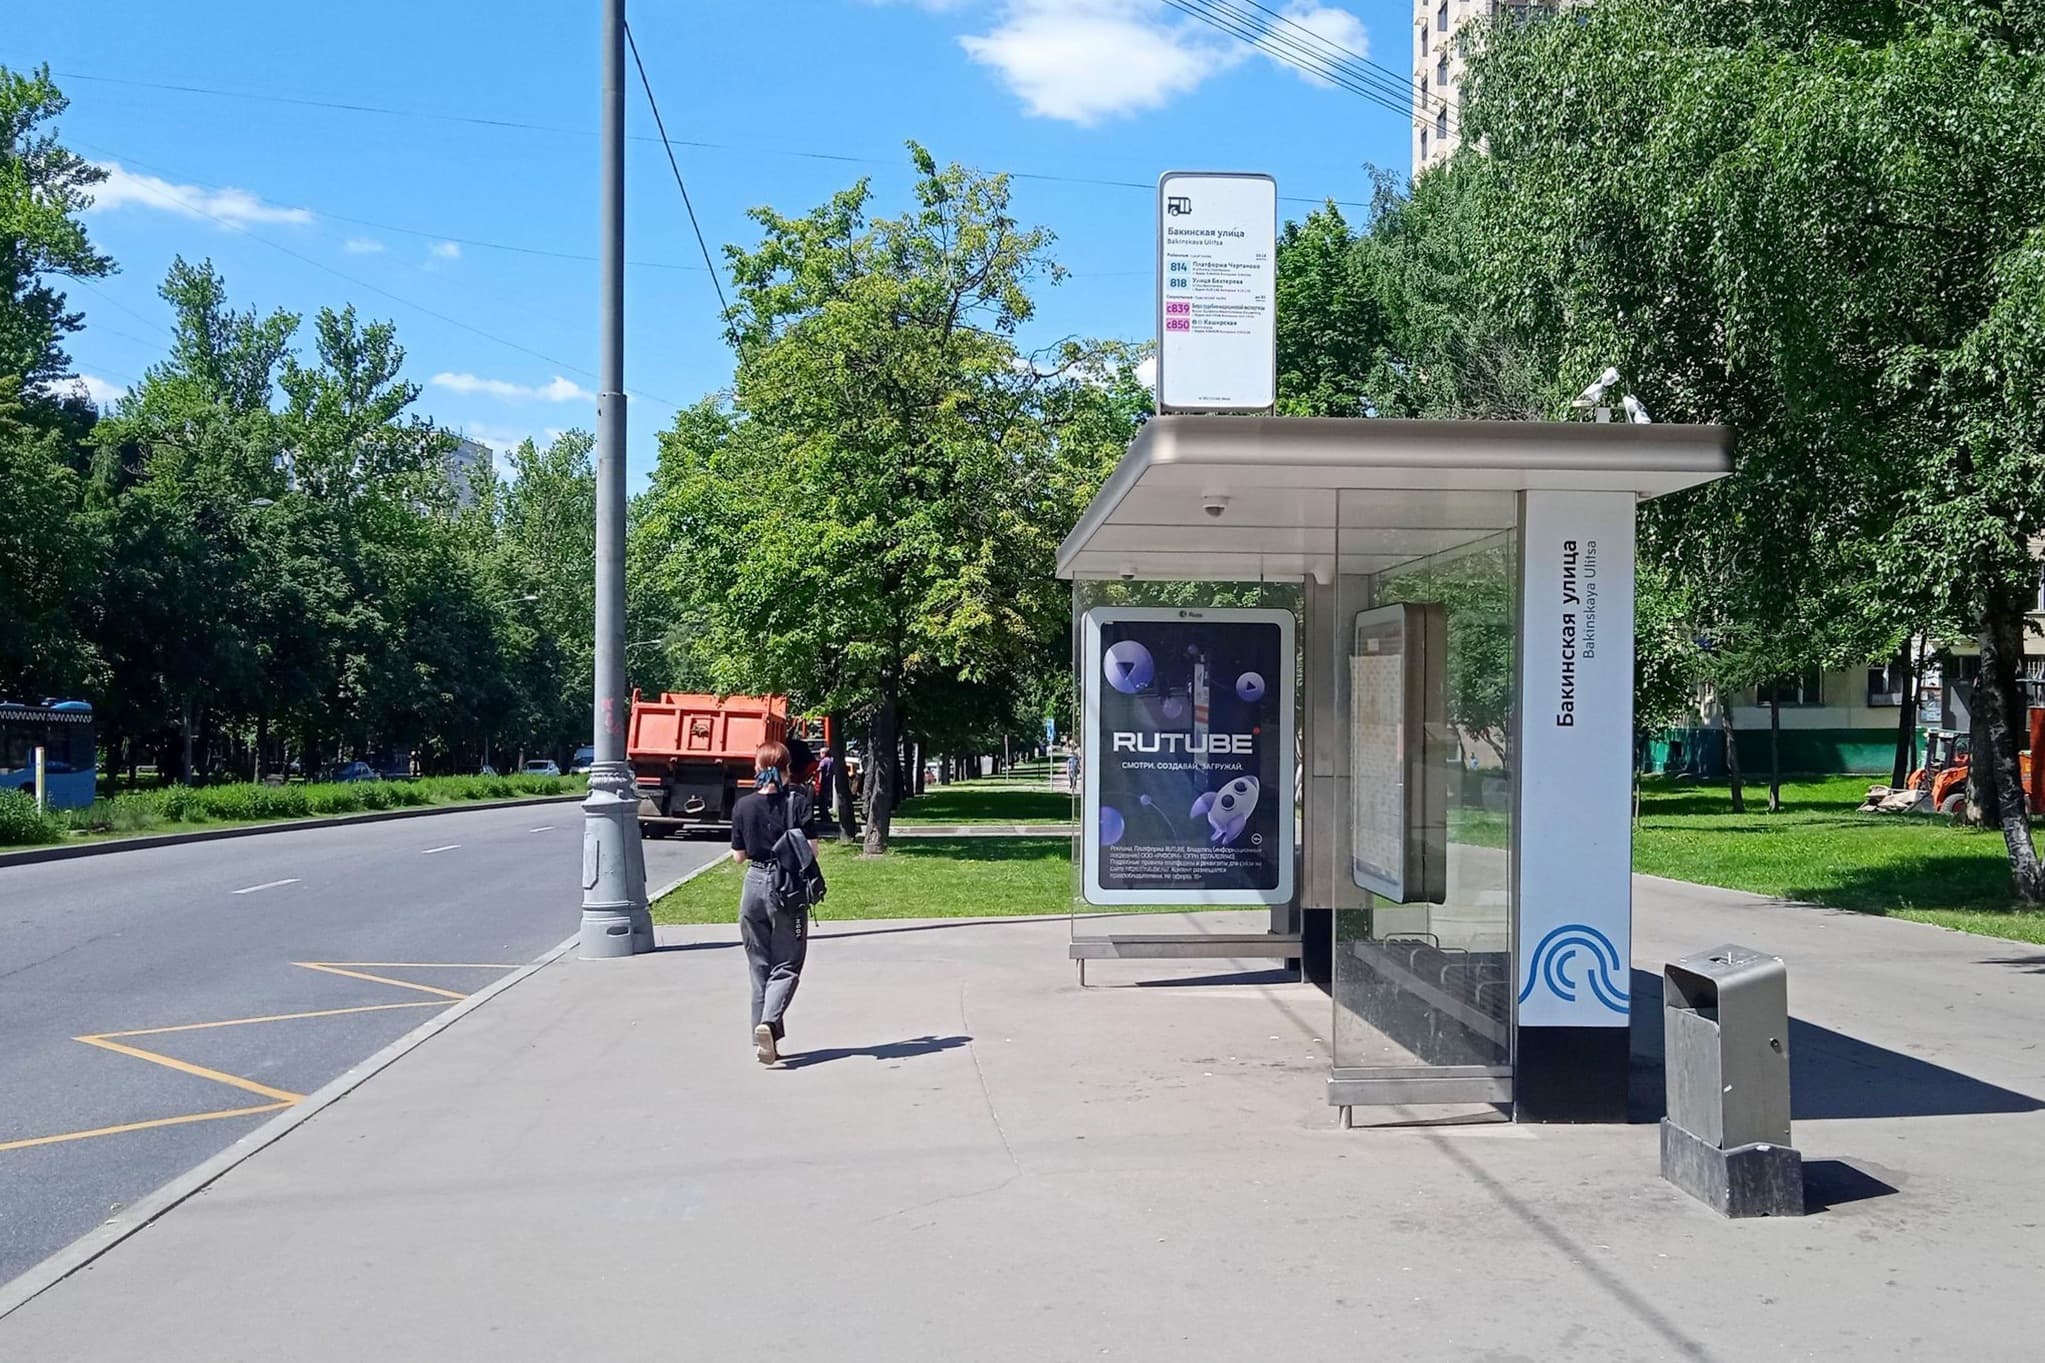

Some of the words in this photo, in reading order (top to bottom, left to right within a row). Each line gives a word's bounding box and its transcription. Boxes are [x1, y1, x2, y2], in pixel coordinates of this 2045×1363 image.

[1167, 227, 1215, 237] Бакинская
[1217, 229, 1245, 239] улица
[1170, 262, 1187, 271] 814
[1192, 261, 1227, 269] Платформа
[1170, 279, 1187, 288] 818
[1584, 540, 1597, 578] Ulitsa
[1562, 540, 1580, 605] улица
[1582, 583, 1598, 659] Bakinskaya
[1556, 613, 1576, 727] Бакинская
[1113, 732, 1253, 755] RUTUBE
[1121, 761, 1156, 770] СМОТРИ.
[1157, 762, 1199, 771] СОЗДАВАЙ.
[1201, 762, 1244, 771] ЗАГРУЖАЙ.
